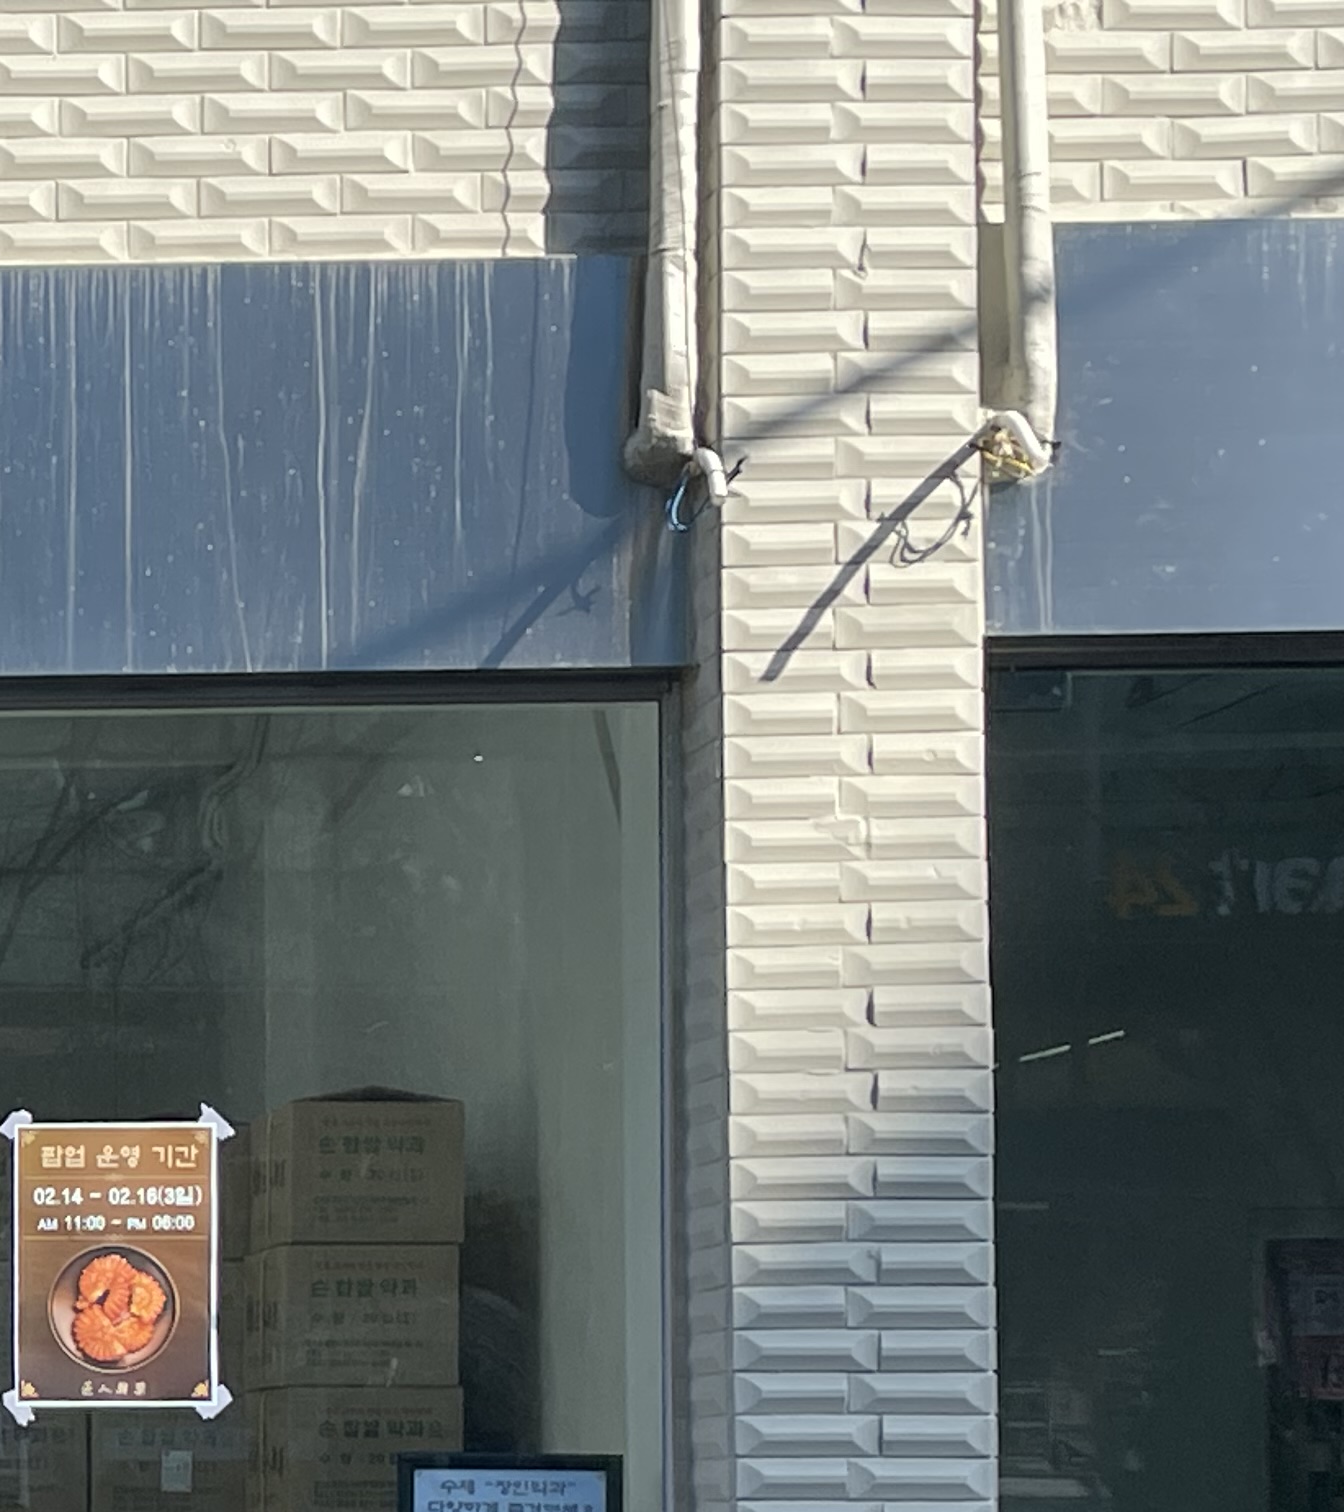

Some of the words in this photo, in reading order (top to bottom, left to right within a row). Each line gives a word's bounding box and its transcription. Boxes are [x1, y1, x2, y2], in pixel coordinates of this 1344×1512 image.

[41, 1144, 86, 1168] 팝업
[96, 1144, 141, 1168] 운영
[152, 1144, 199, 1168] 기간
[33, 1187, 83, 1205] 02.14
[109, 1185, 202, 1207] 02.16(3일)
[37, 1218, 58, 1230] AM
[64, 1215, 106, 1231] 11:00
[127, 1217, 146, 1230] PM
[440, 1479, 475, 1495] 수제
